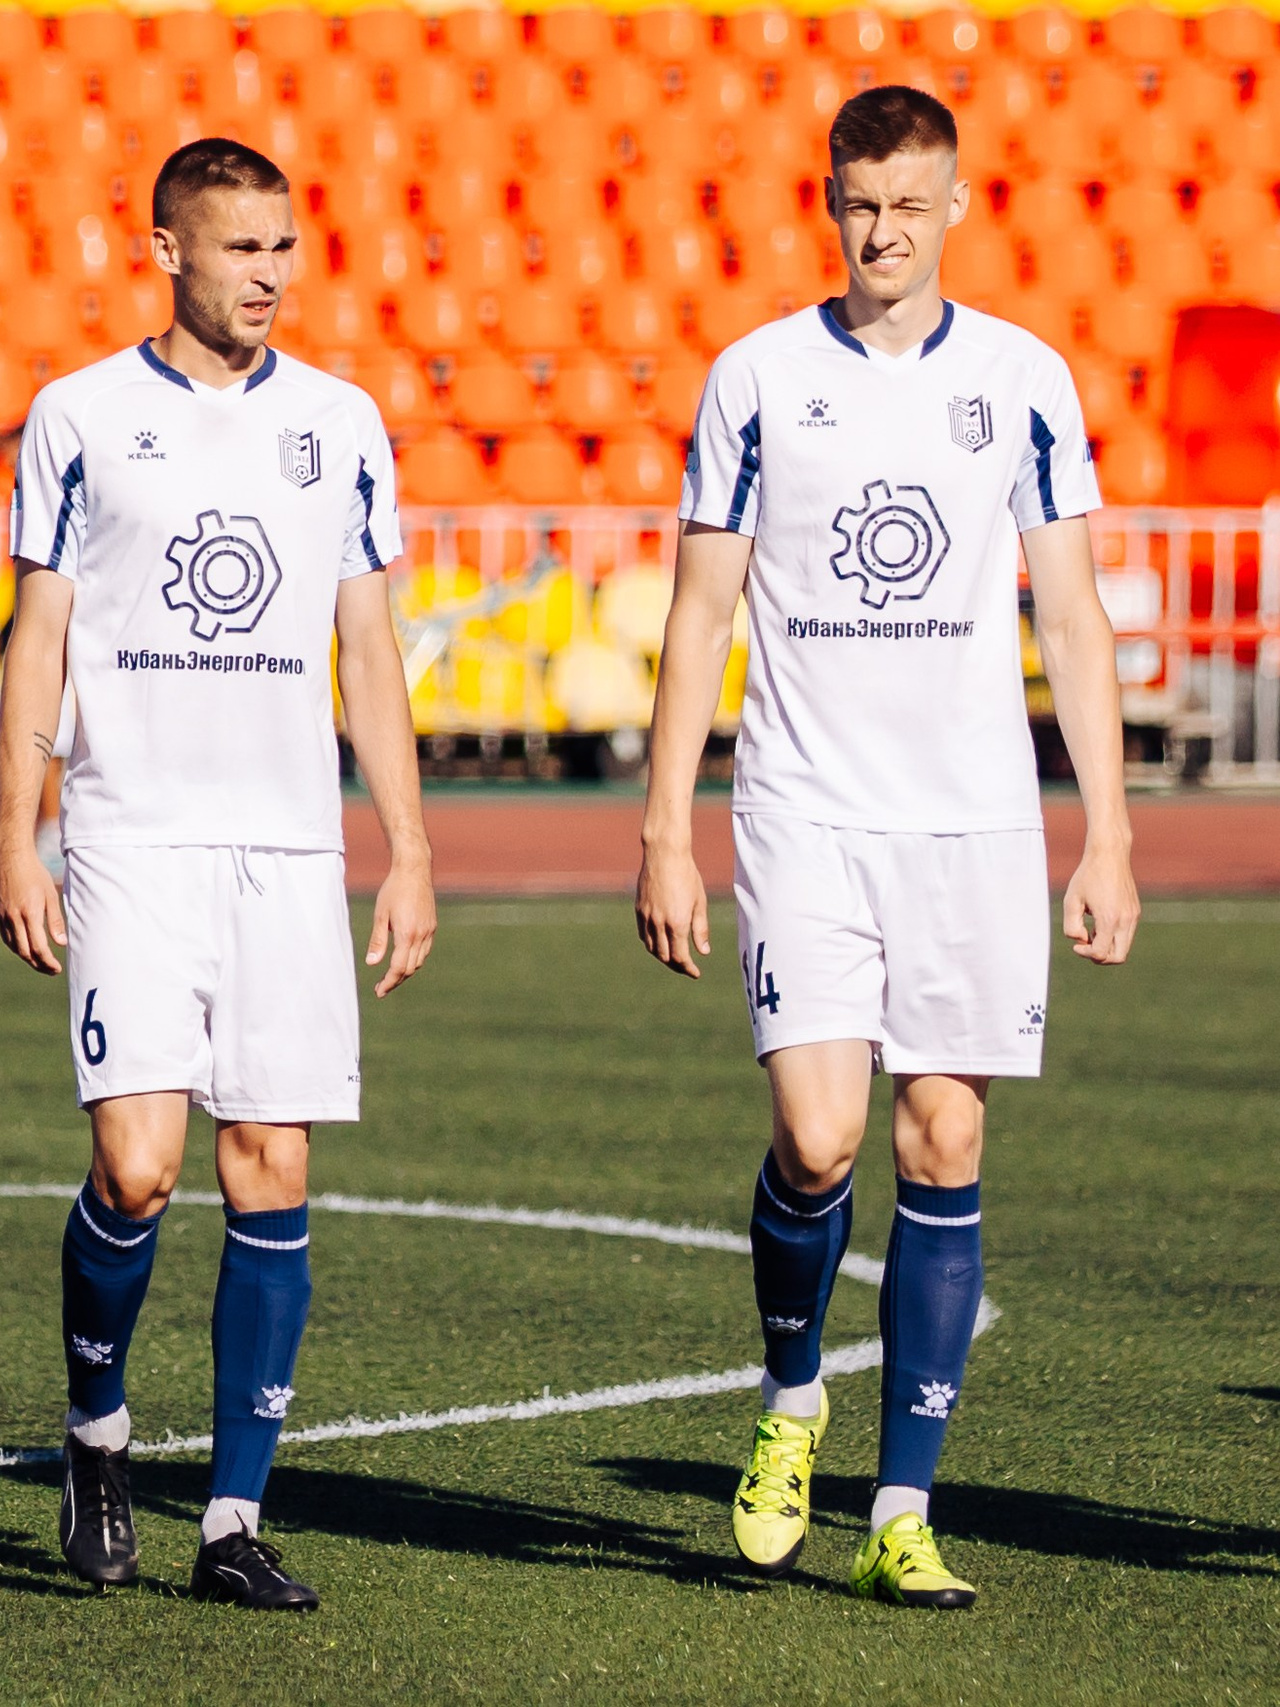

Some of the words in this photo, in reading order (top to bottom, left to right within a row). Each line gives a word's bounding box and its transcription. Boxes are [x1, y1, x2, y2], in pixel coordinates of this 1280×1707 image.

[798, 419, 838, 427] KELME
[127, 452, 167, 460] KELME
[787, 617, 974, 640] КубаньЭнергоРемнт
[116, 649, 305, 675] КубаньЭнергоРемо
[81, 987, 107, 1067] 6
[1018, 1027, 1044, 1035] KEL
